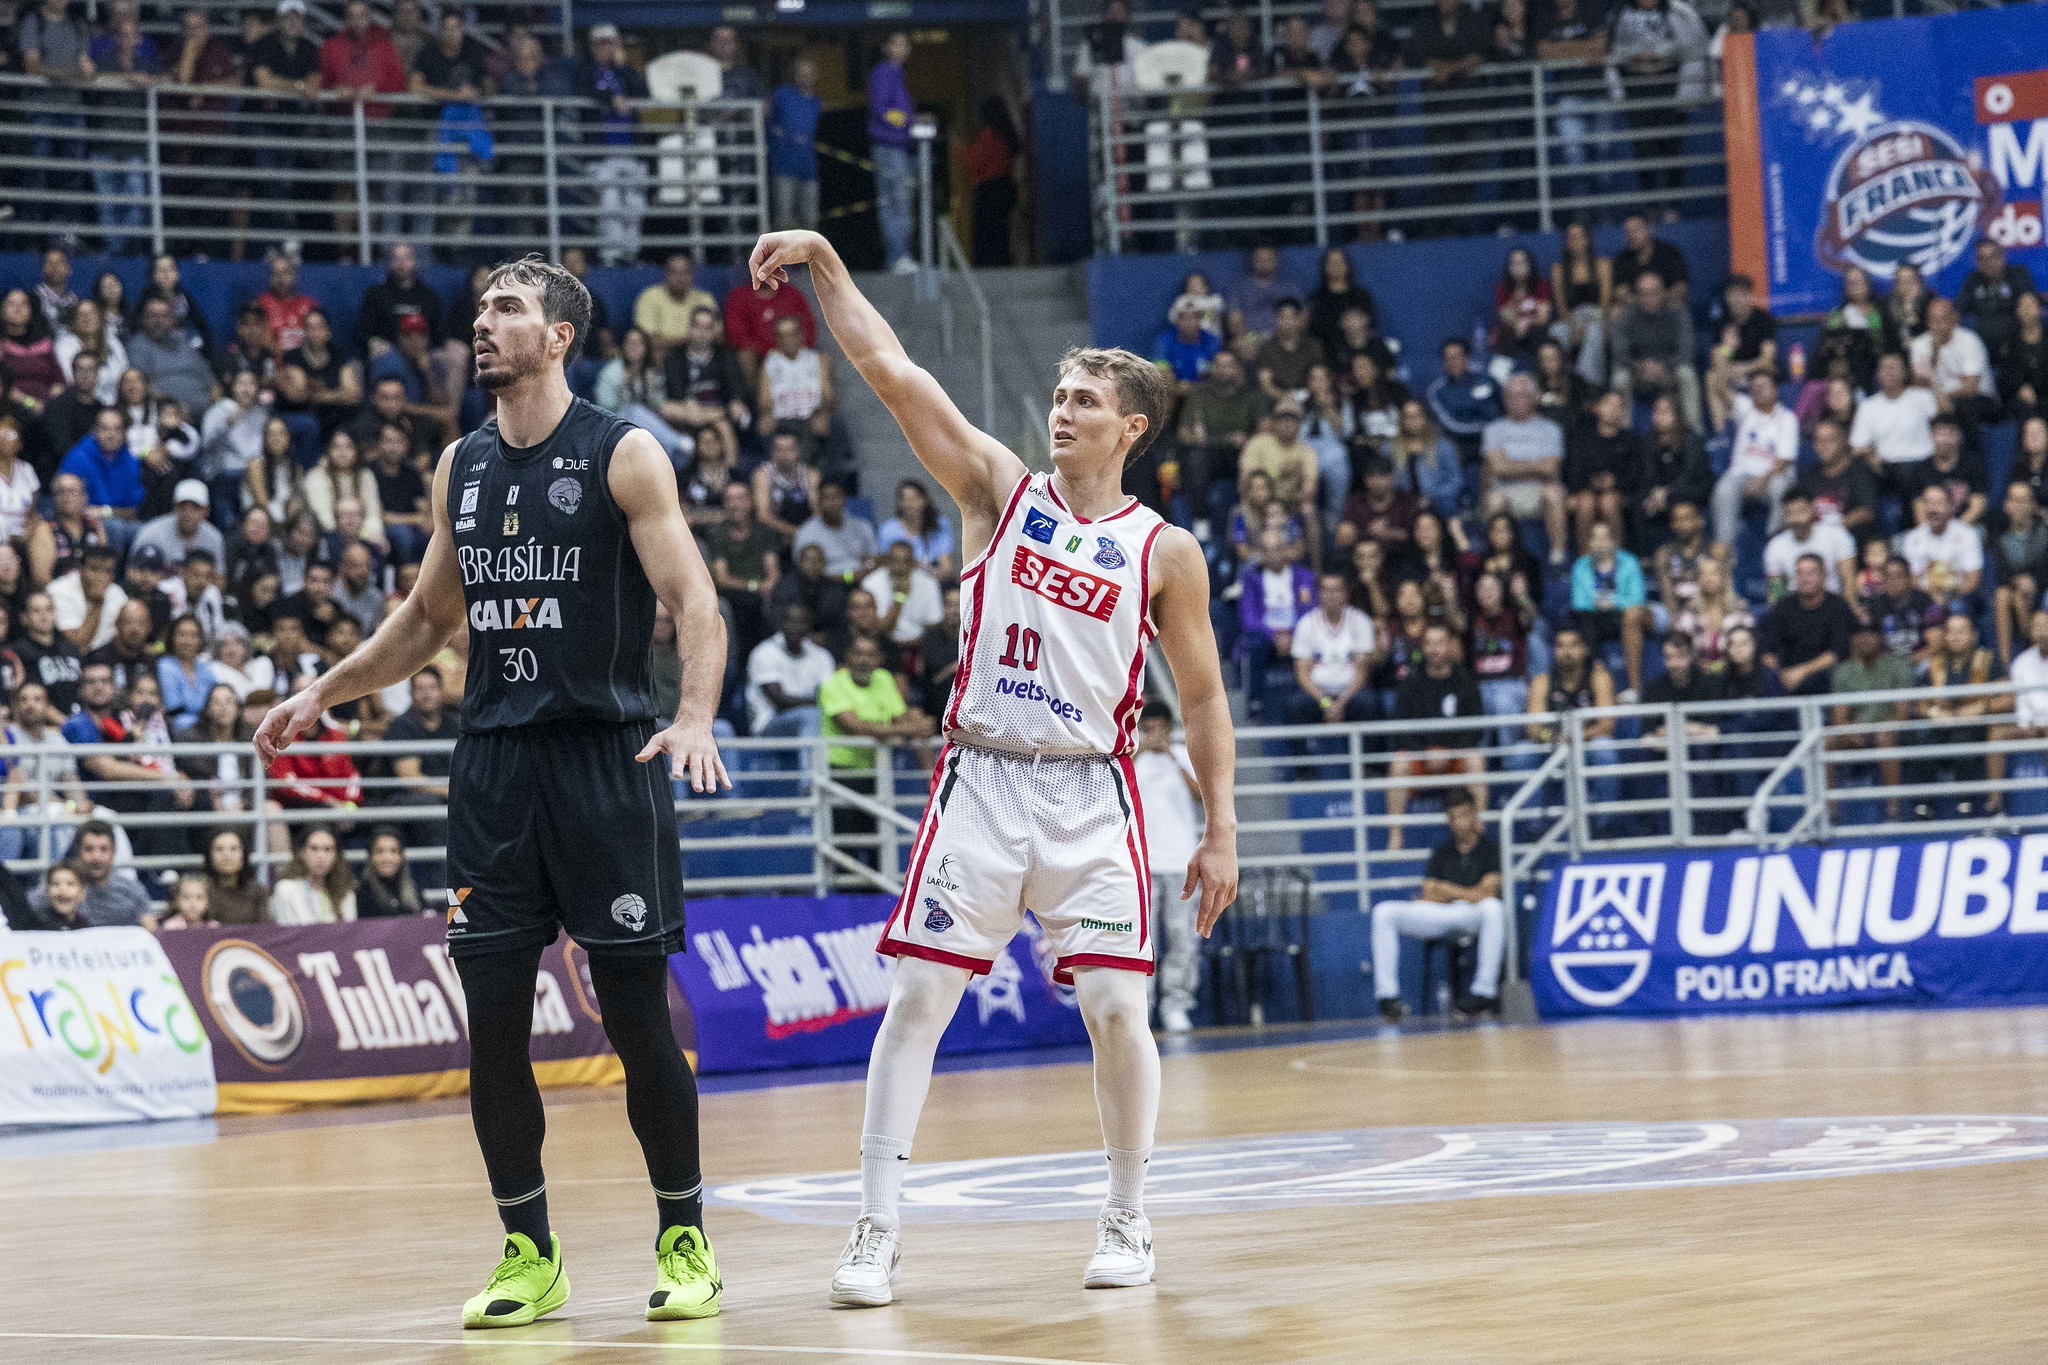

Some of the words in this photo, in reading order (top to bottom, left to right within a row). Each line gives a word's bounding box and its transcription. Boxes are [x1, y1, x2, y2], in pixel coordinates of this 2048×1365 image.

[1028, 485, 1052, 504] LARU
[458, 537, 582, 586] BRASÍLIA
[1019, 555, 1113, 614] SESI
[470, 597, 563, 631] CAIXA
[499, 647, 539, 682] 30
[998, 622, 1042, 672] 10
[927, 876, 957, 892] LARULP
[28, 947, 155, 969] Prefeitura
[1676, 964, 1769, 1001] POLO
[1774, 952, 1914, 998] FRANCA
[298, 948, 459, 1051] Tulha
